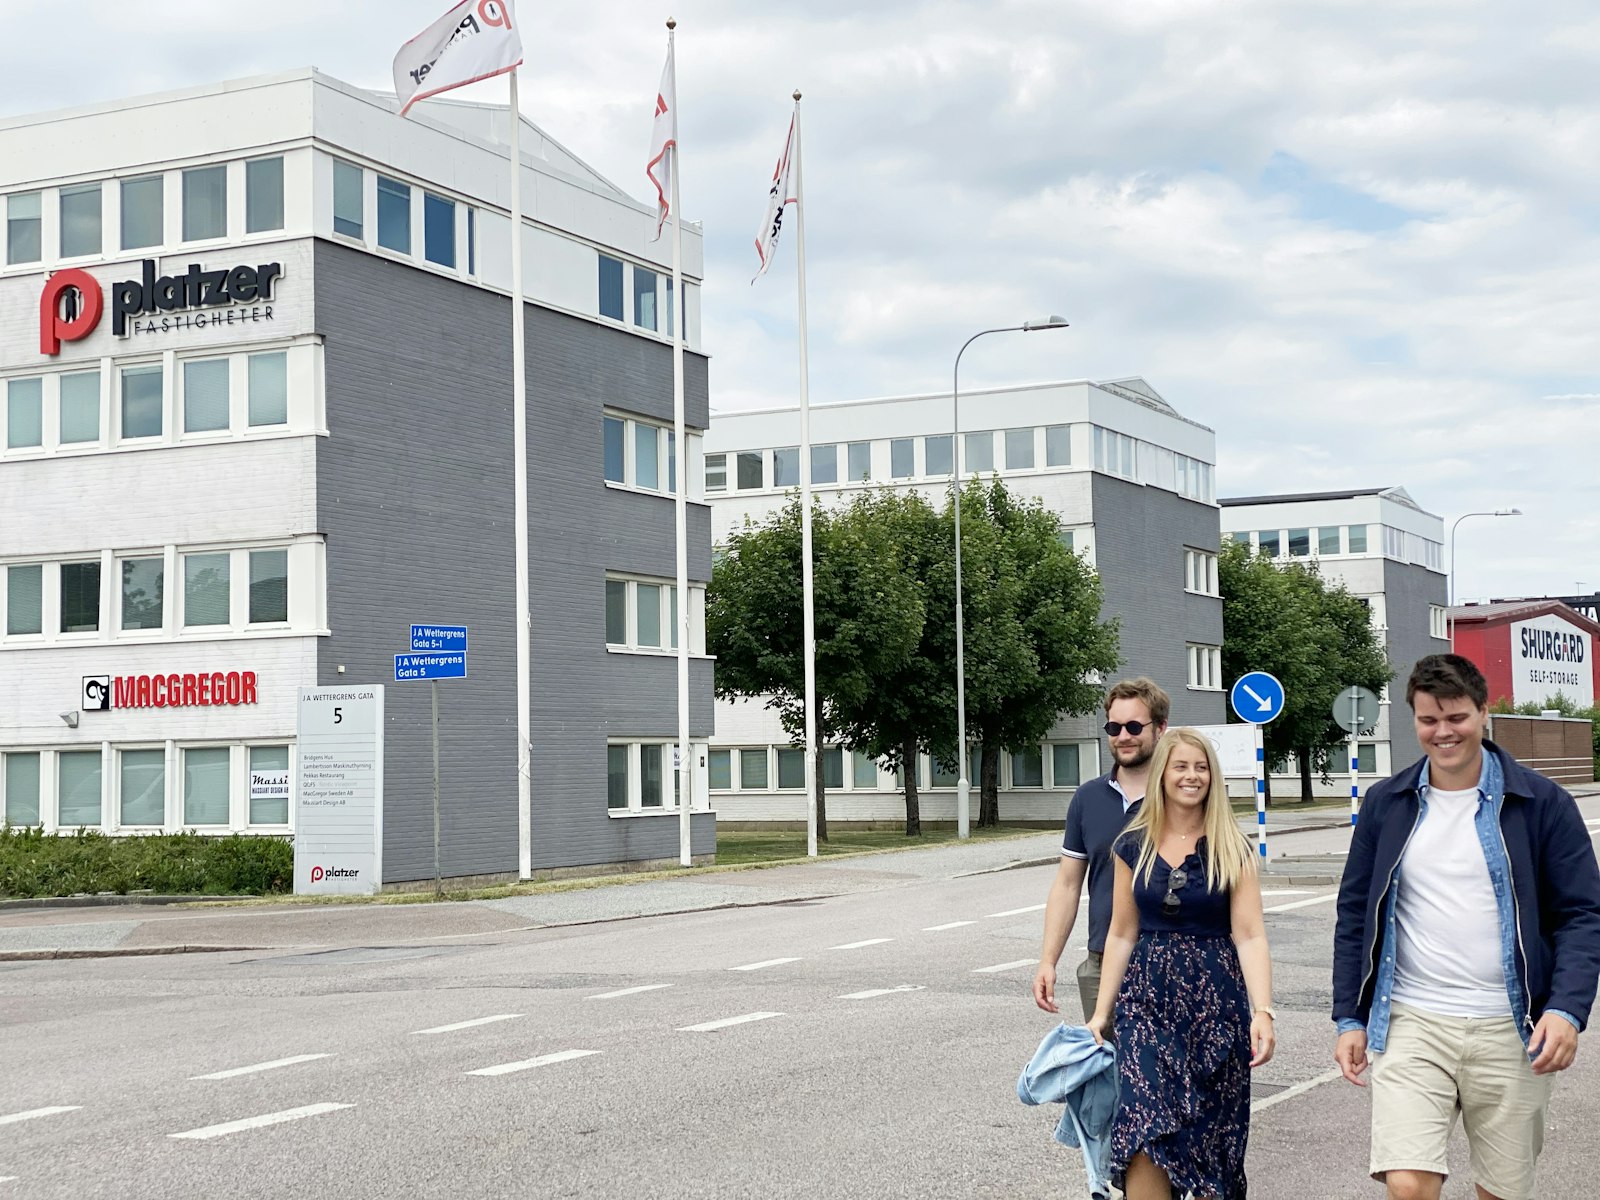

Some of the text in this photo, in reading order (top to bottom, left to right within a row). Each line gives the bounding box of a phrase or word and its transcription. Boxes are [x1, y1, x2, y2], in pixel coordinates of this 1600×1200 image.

[112, 259, 281, 336] platzer
[135, 306, 274, 335] FASTIGHETER
[413, 628, 465, 639] J A Wettergrens
[413, 639, 442, 648] Gata 5-1
[1521, 627, 1584, 663] SHURGARD
[398, 656, 463, 667] J A Wettergrens
[398, 667, 426, 677] Gata 5
[114, 671, 257, 709] MACGREGOR
[313, 693, 356, 701] WETTERGRENS
[358, 692, 374, 700] GATA
[334, 707, 343, 724] 5
[323, 799, 338, 807] Design
[325, 866, 360, 881] platzer
